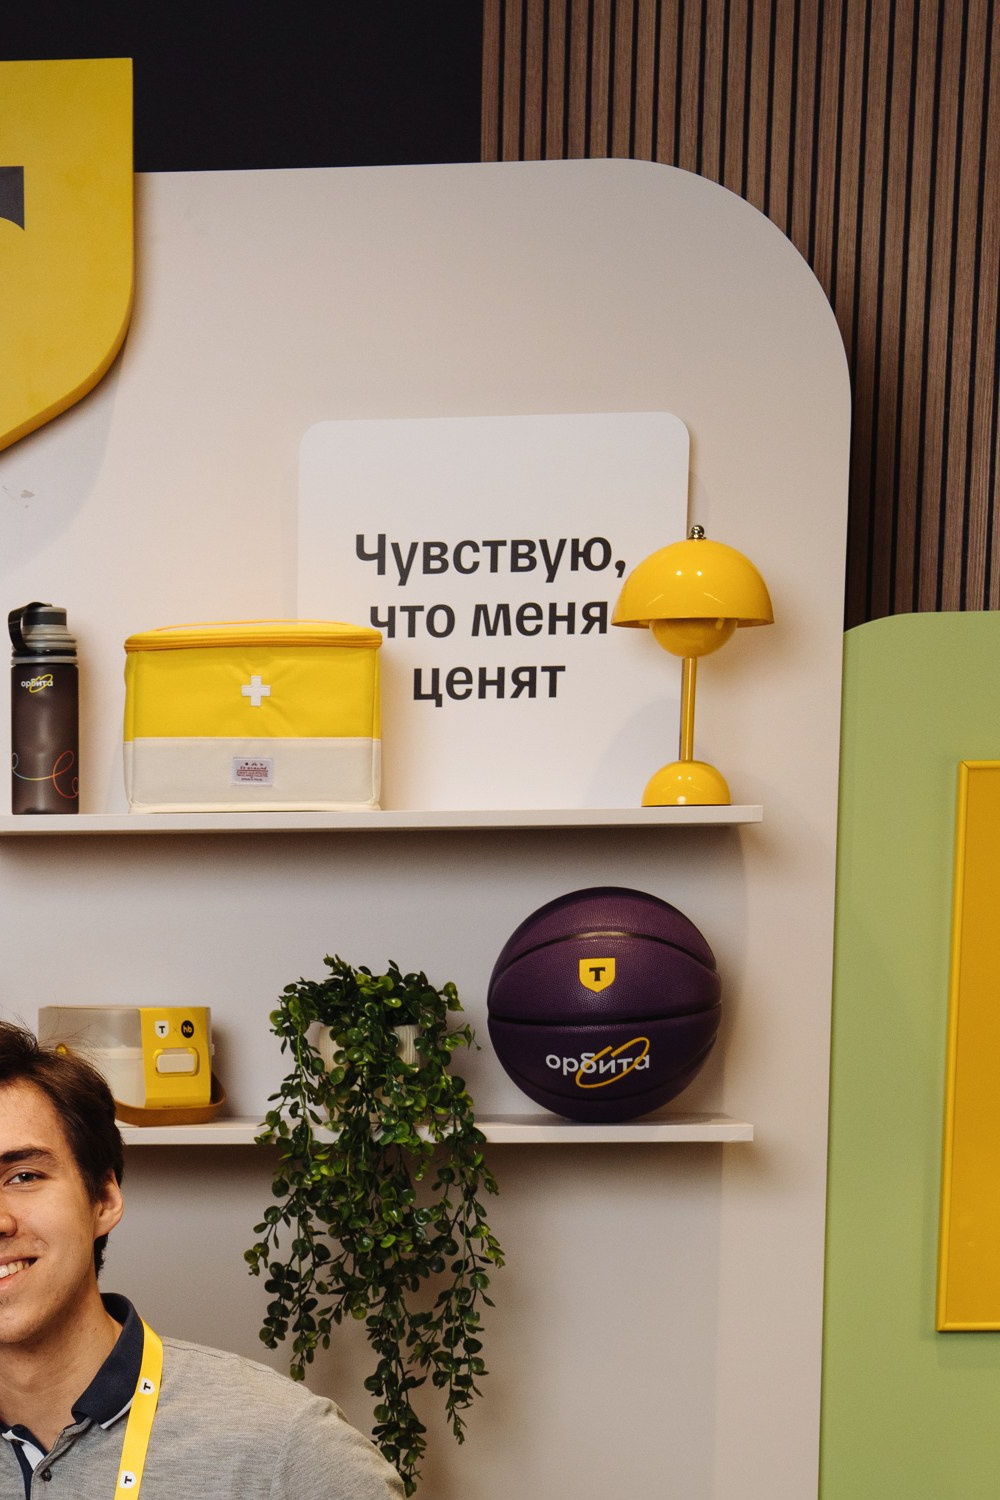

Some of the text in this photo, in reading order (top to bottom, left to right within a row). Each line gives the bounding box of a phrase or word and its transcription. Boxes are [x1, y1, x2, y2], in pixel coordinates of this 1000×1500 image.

[356, 533, 626, 586] Чувствую,
[370, 601, 608, 638] что меня
[413, 665, 566, 708] ценят
[545, 1052, 650, 1076] орбита
